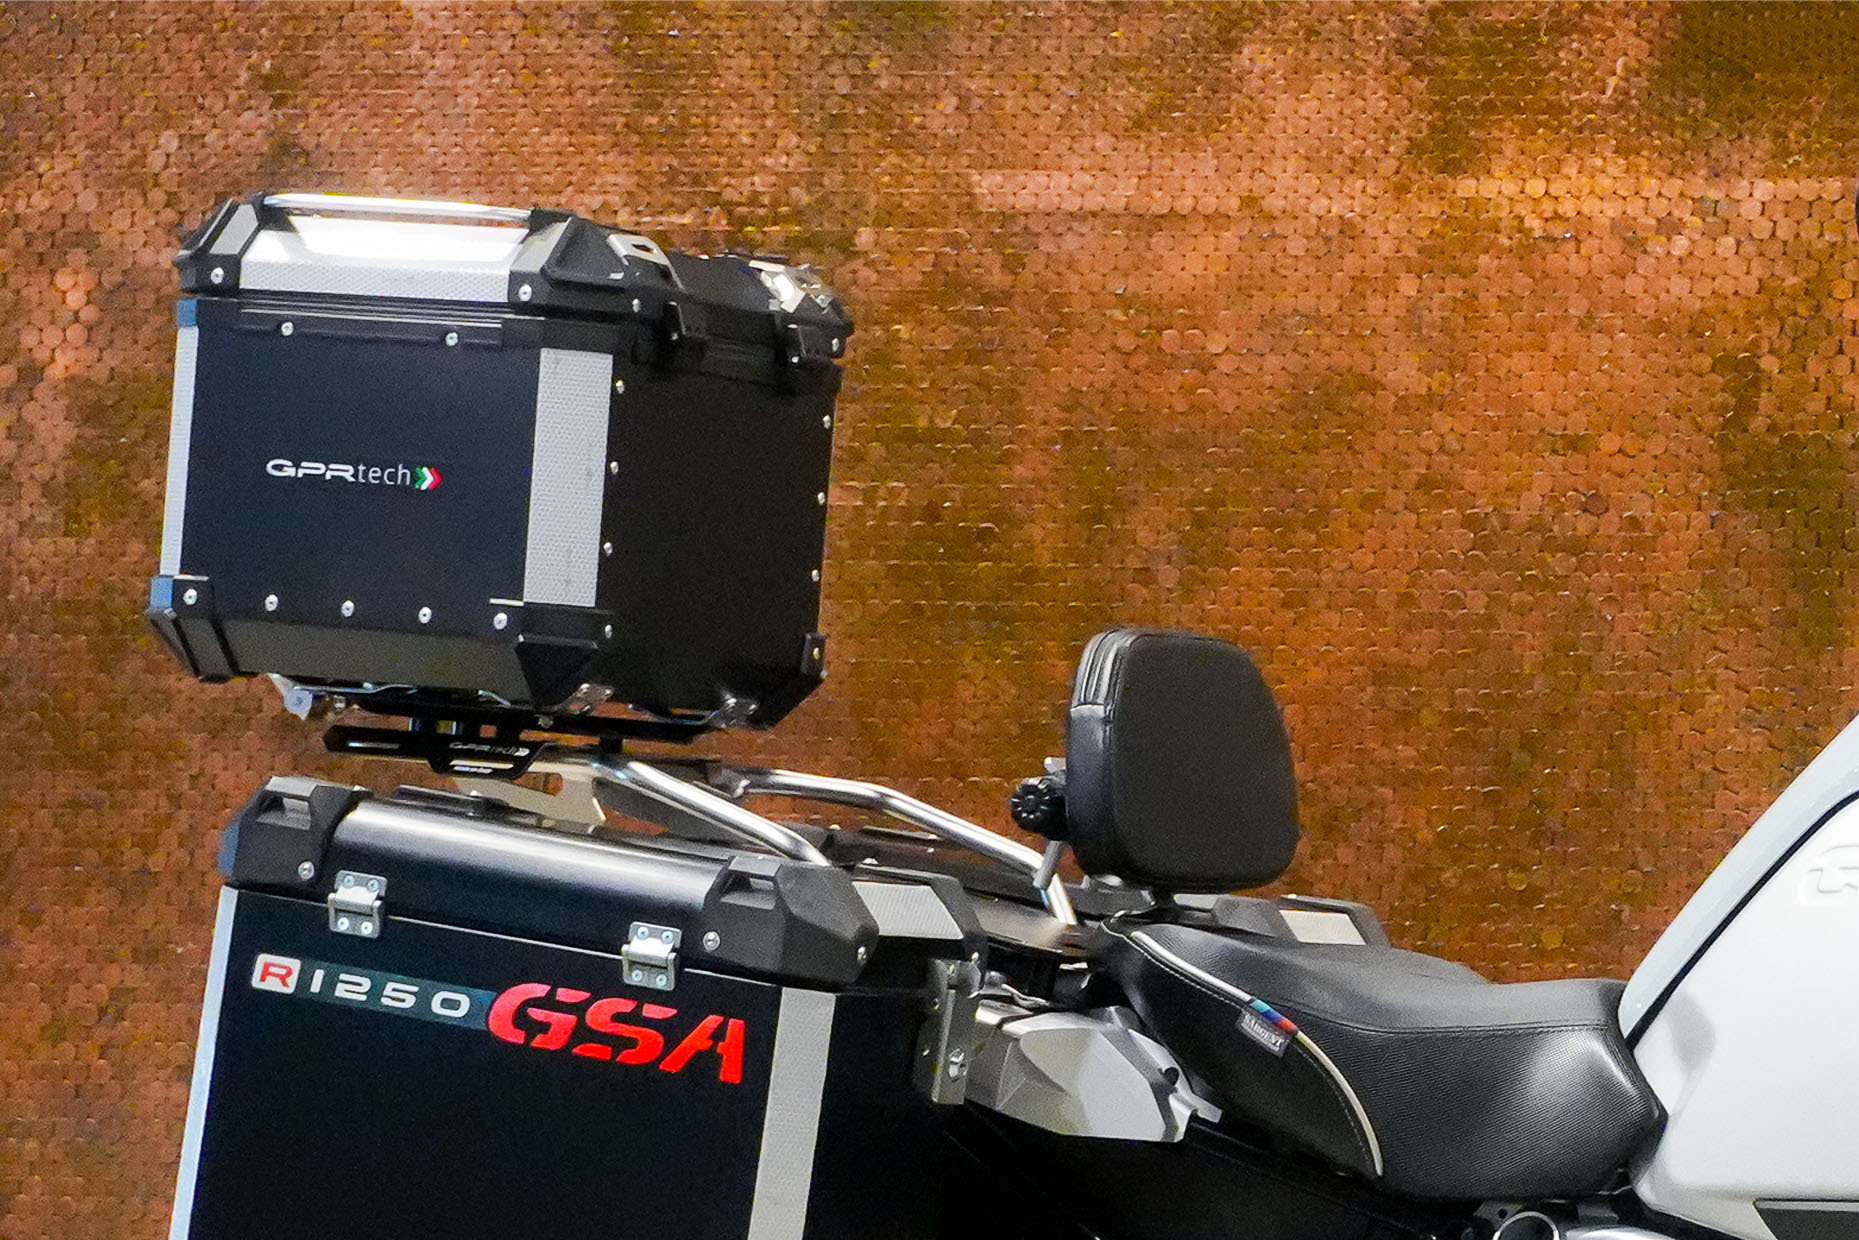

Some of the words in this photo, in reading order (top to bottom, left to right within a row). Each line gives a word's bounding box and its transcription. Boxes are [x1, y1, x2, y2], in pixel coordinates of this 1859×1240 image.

[266, 458, 411, 486] GPRtech
[259, 961, 293, 988] R
[309, 968, 472, 1019] 1250
[487, 982, 746, 1085] GSA
